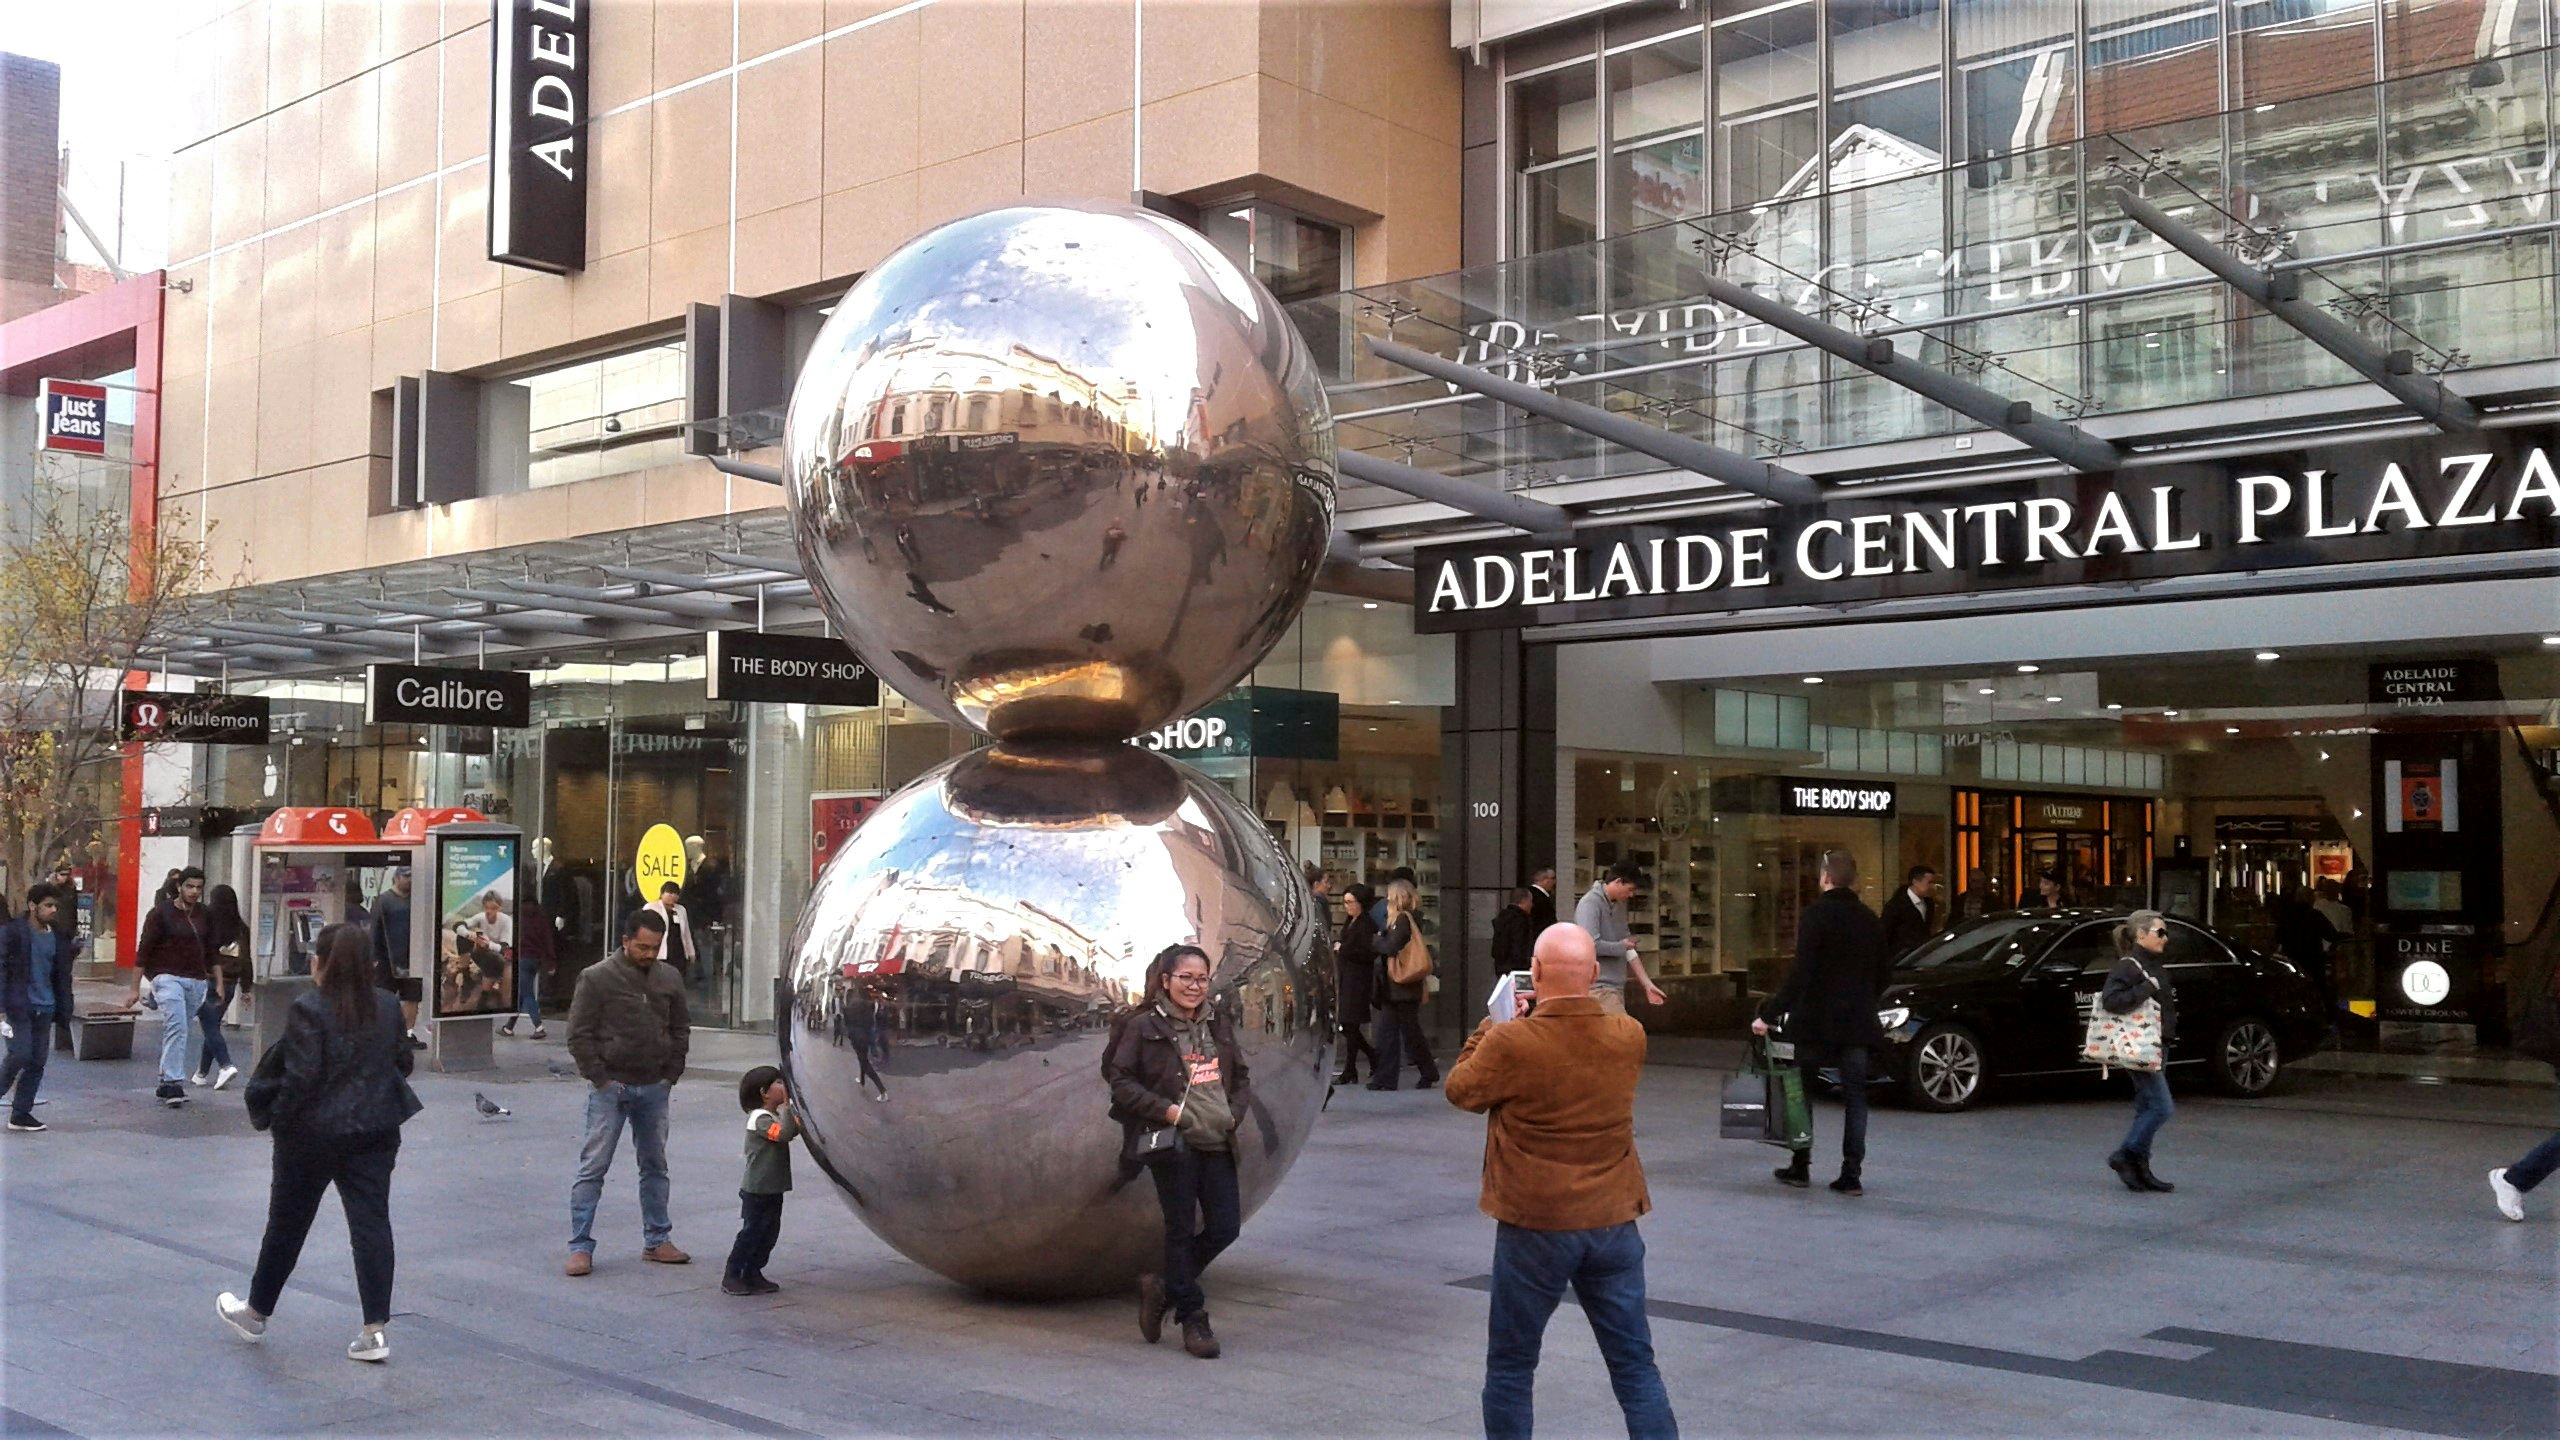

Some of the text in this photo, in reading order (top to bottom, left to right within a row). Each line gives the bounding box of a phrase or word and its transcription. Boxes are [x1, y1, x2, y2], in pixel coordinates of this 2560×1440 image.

[60, 396, 96, 418] Just
[52, 413, 101, 436] Jeans
[1428, 447, 2560, 612] ADELAIDE CENTRAL PLAZA
[731, 656, 865, 680] THE BODY SHOP
[2384, 667, 2458, 680] ADELAIDE
[396, 677, 504, 711] Calibre
[2386, 681, 2456, 694] CENTRAL
[2397, 696, 2444, 708] PLAZA
[171, 709, 259, 728] lululemon
[1472, 802, 1499, 818] 100
[1793, 787, 1891, 811] THE BODY SHOP
[642, 854, 679, 877] SALE
